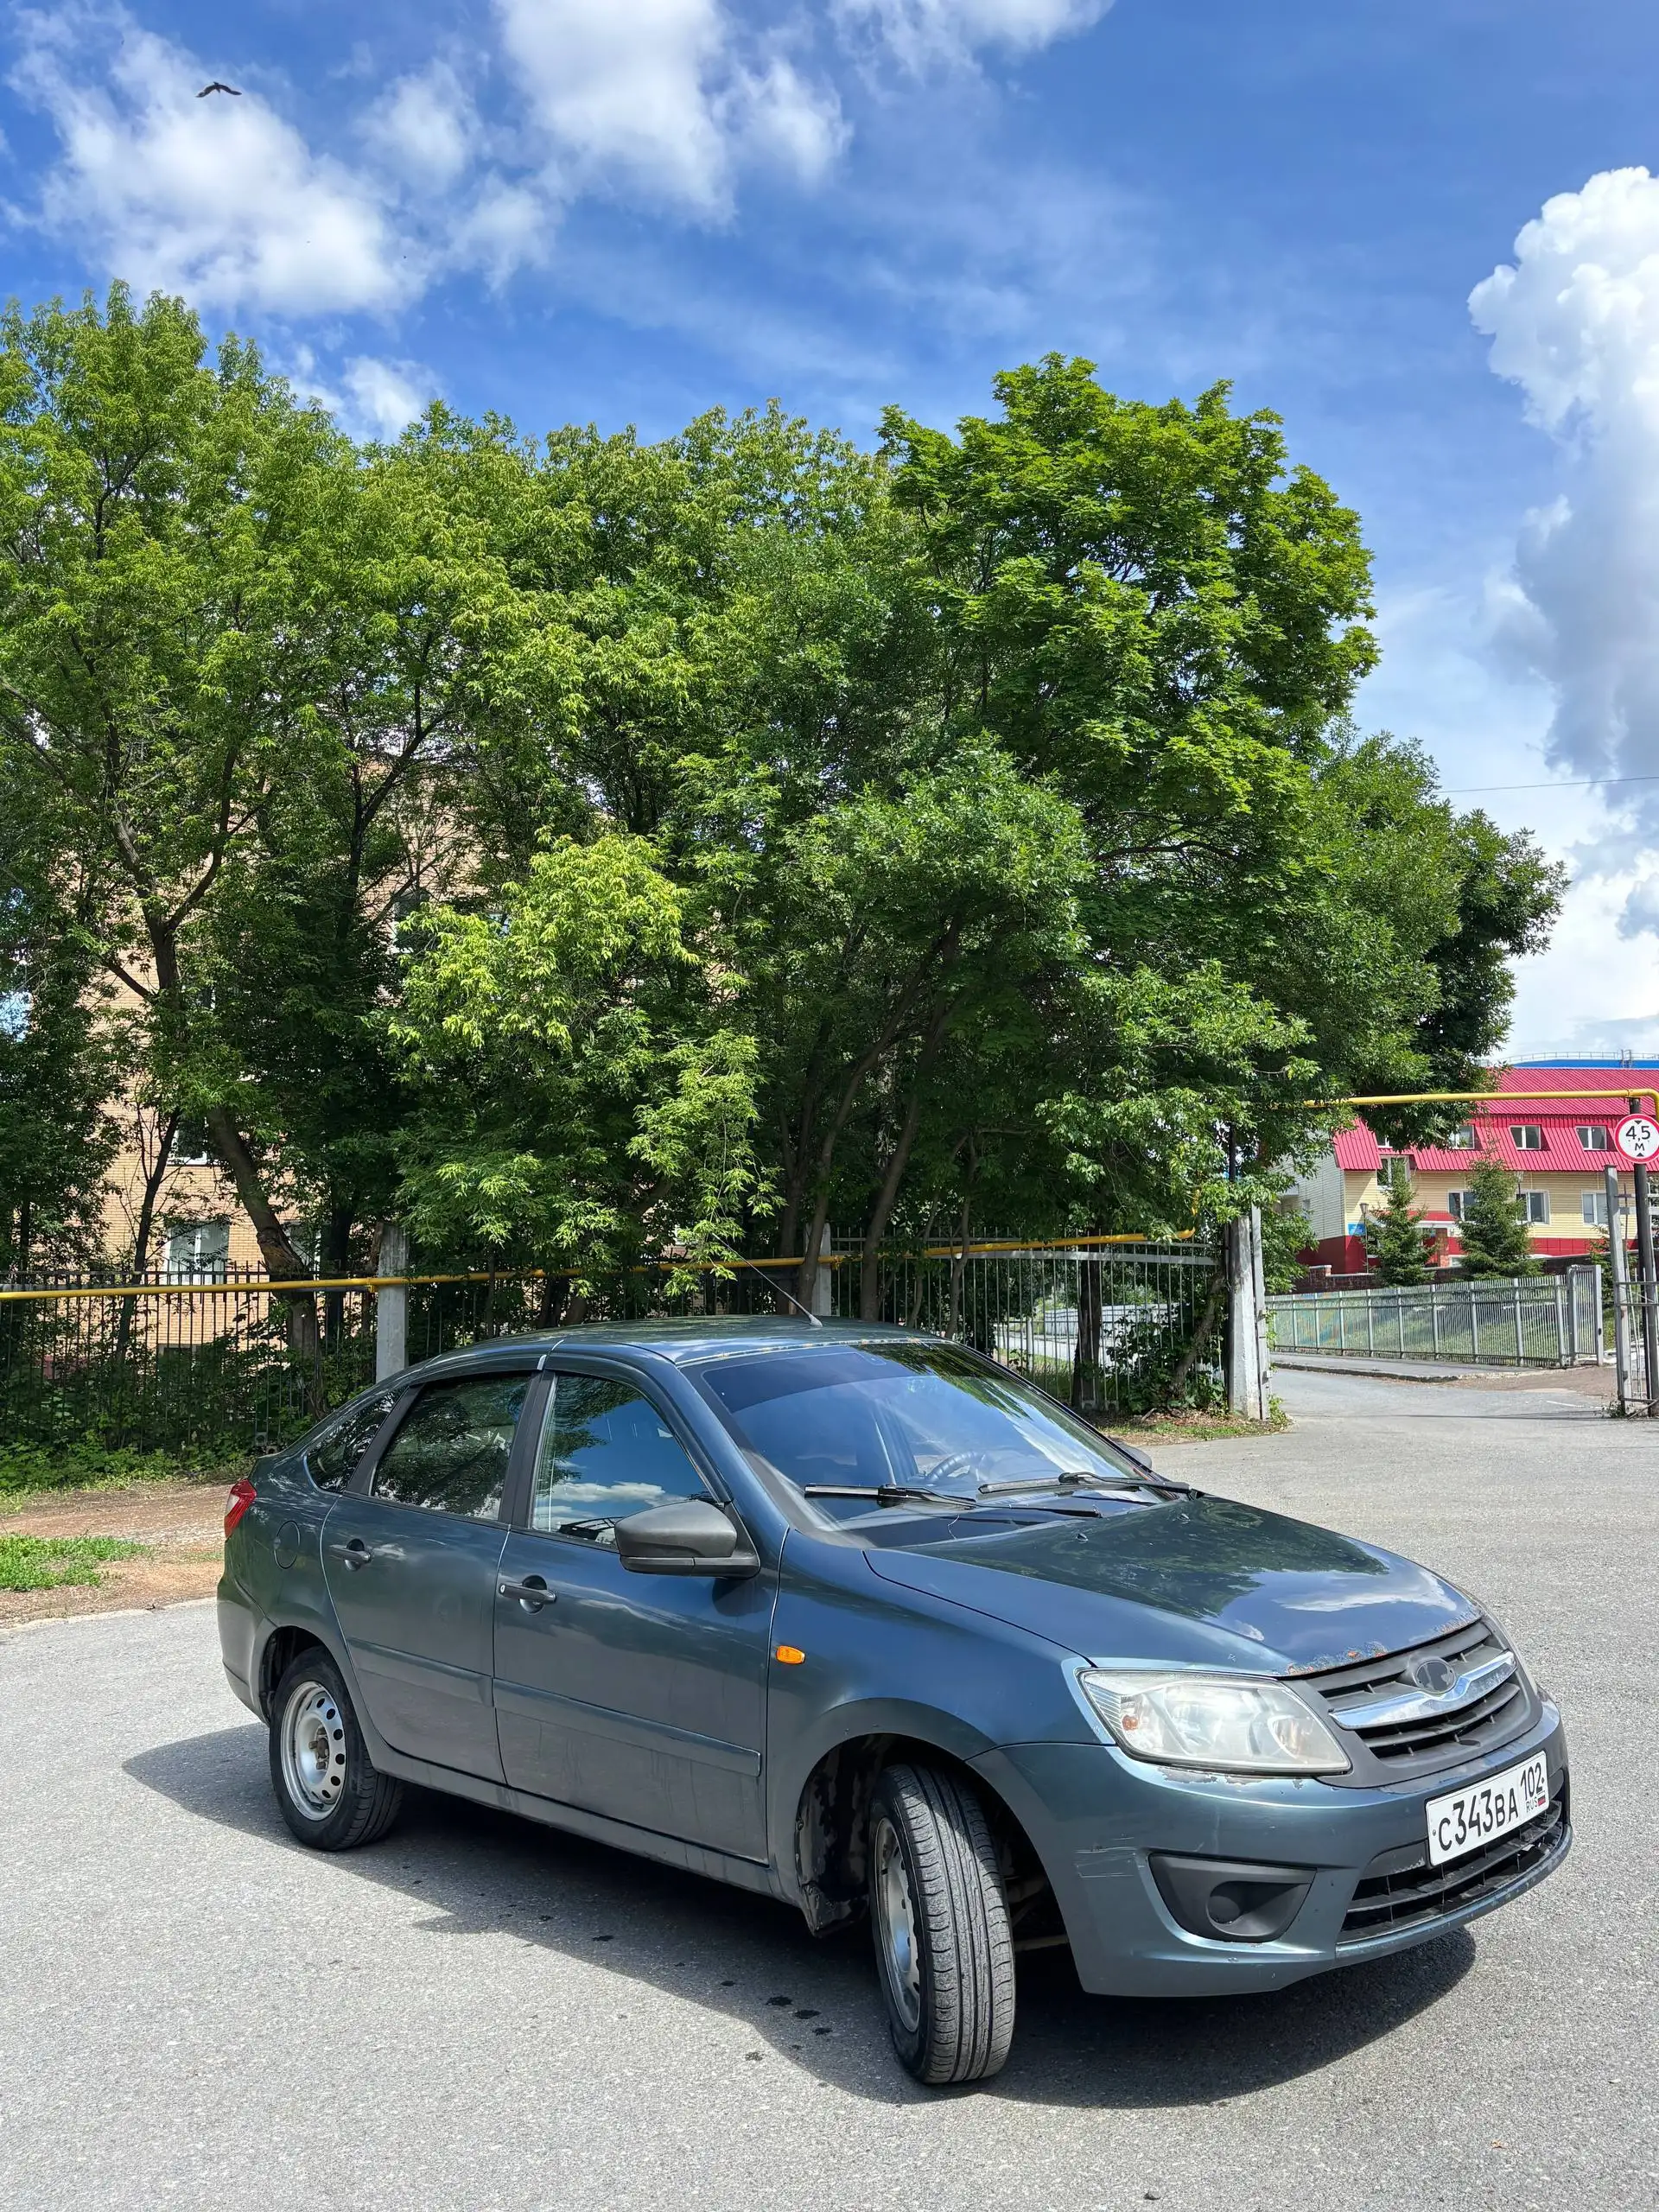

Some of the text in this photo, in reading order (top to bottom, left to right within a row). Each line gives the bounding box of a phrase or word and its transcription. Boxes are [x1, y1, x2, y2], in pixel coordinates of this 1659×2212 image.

[1625, 1125, 1650, 1141] 4,5
[1520, 1762, 1543, 1800] 102
[1526, 1796, 1538, 1813] RUS
